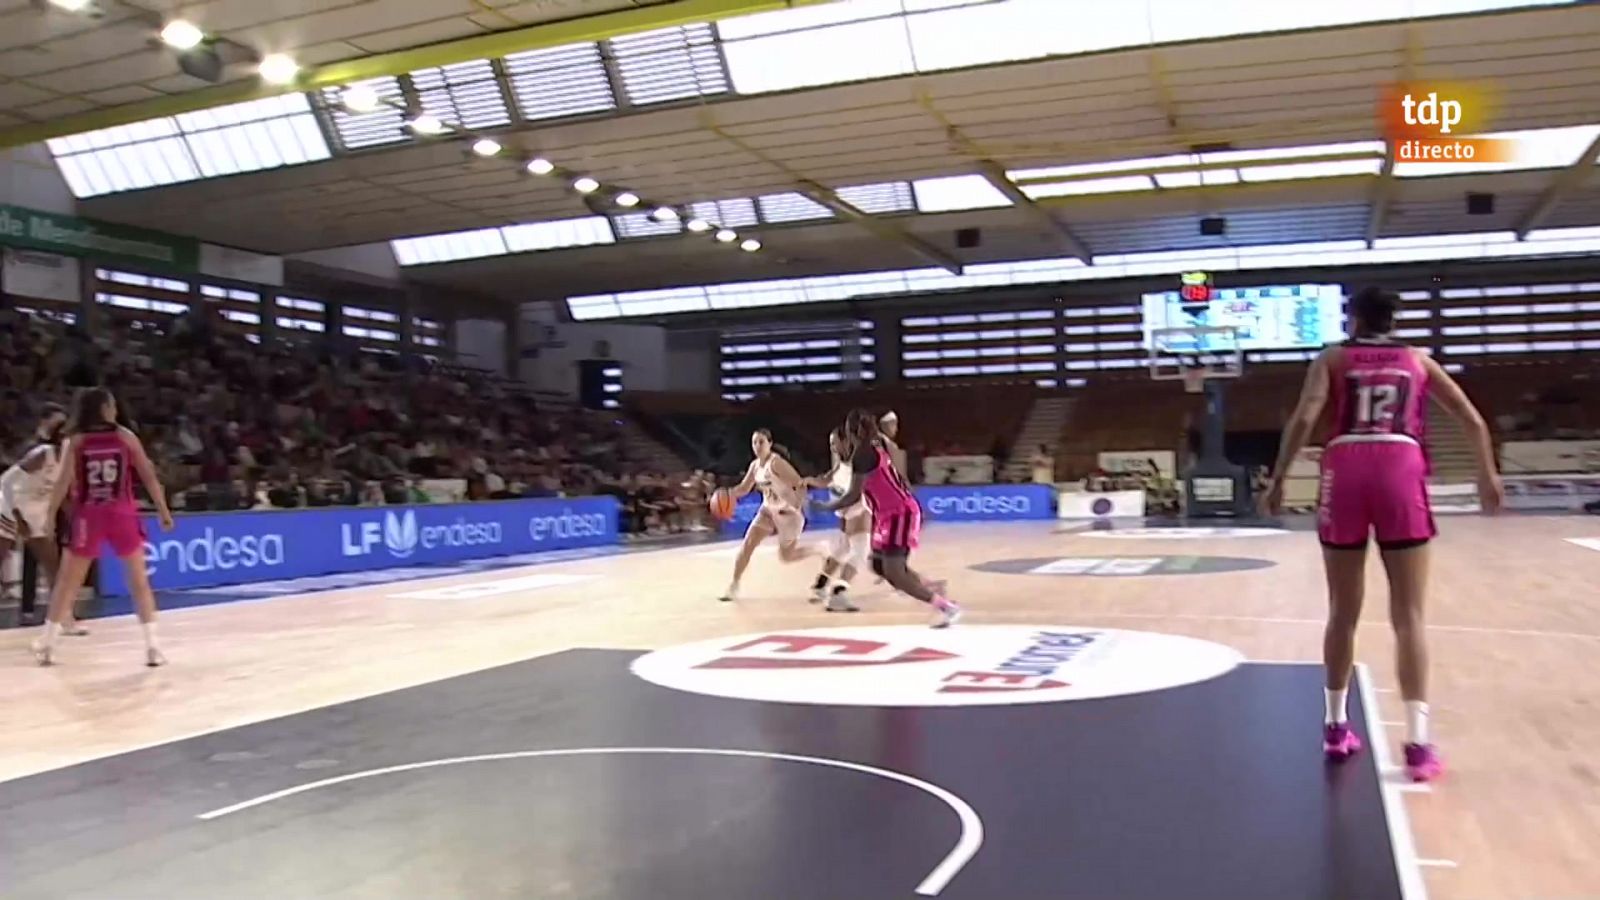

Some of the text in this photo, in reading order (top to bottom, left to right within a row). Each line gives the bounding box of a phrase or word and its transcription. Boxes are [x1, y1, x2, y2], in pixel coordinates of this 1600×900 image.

[1356, 384, 1397, 422] 12
[86, 459, 118, 485] 26
[928, 492, 1031, 514] endesa
[420, 517, 501, 549] endesa
[528, 506, 606, 541] endesa
[144, 526, 284, 575] endesa
